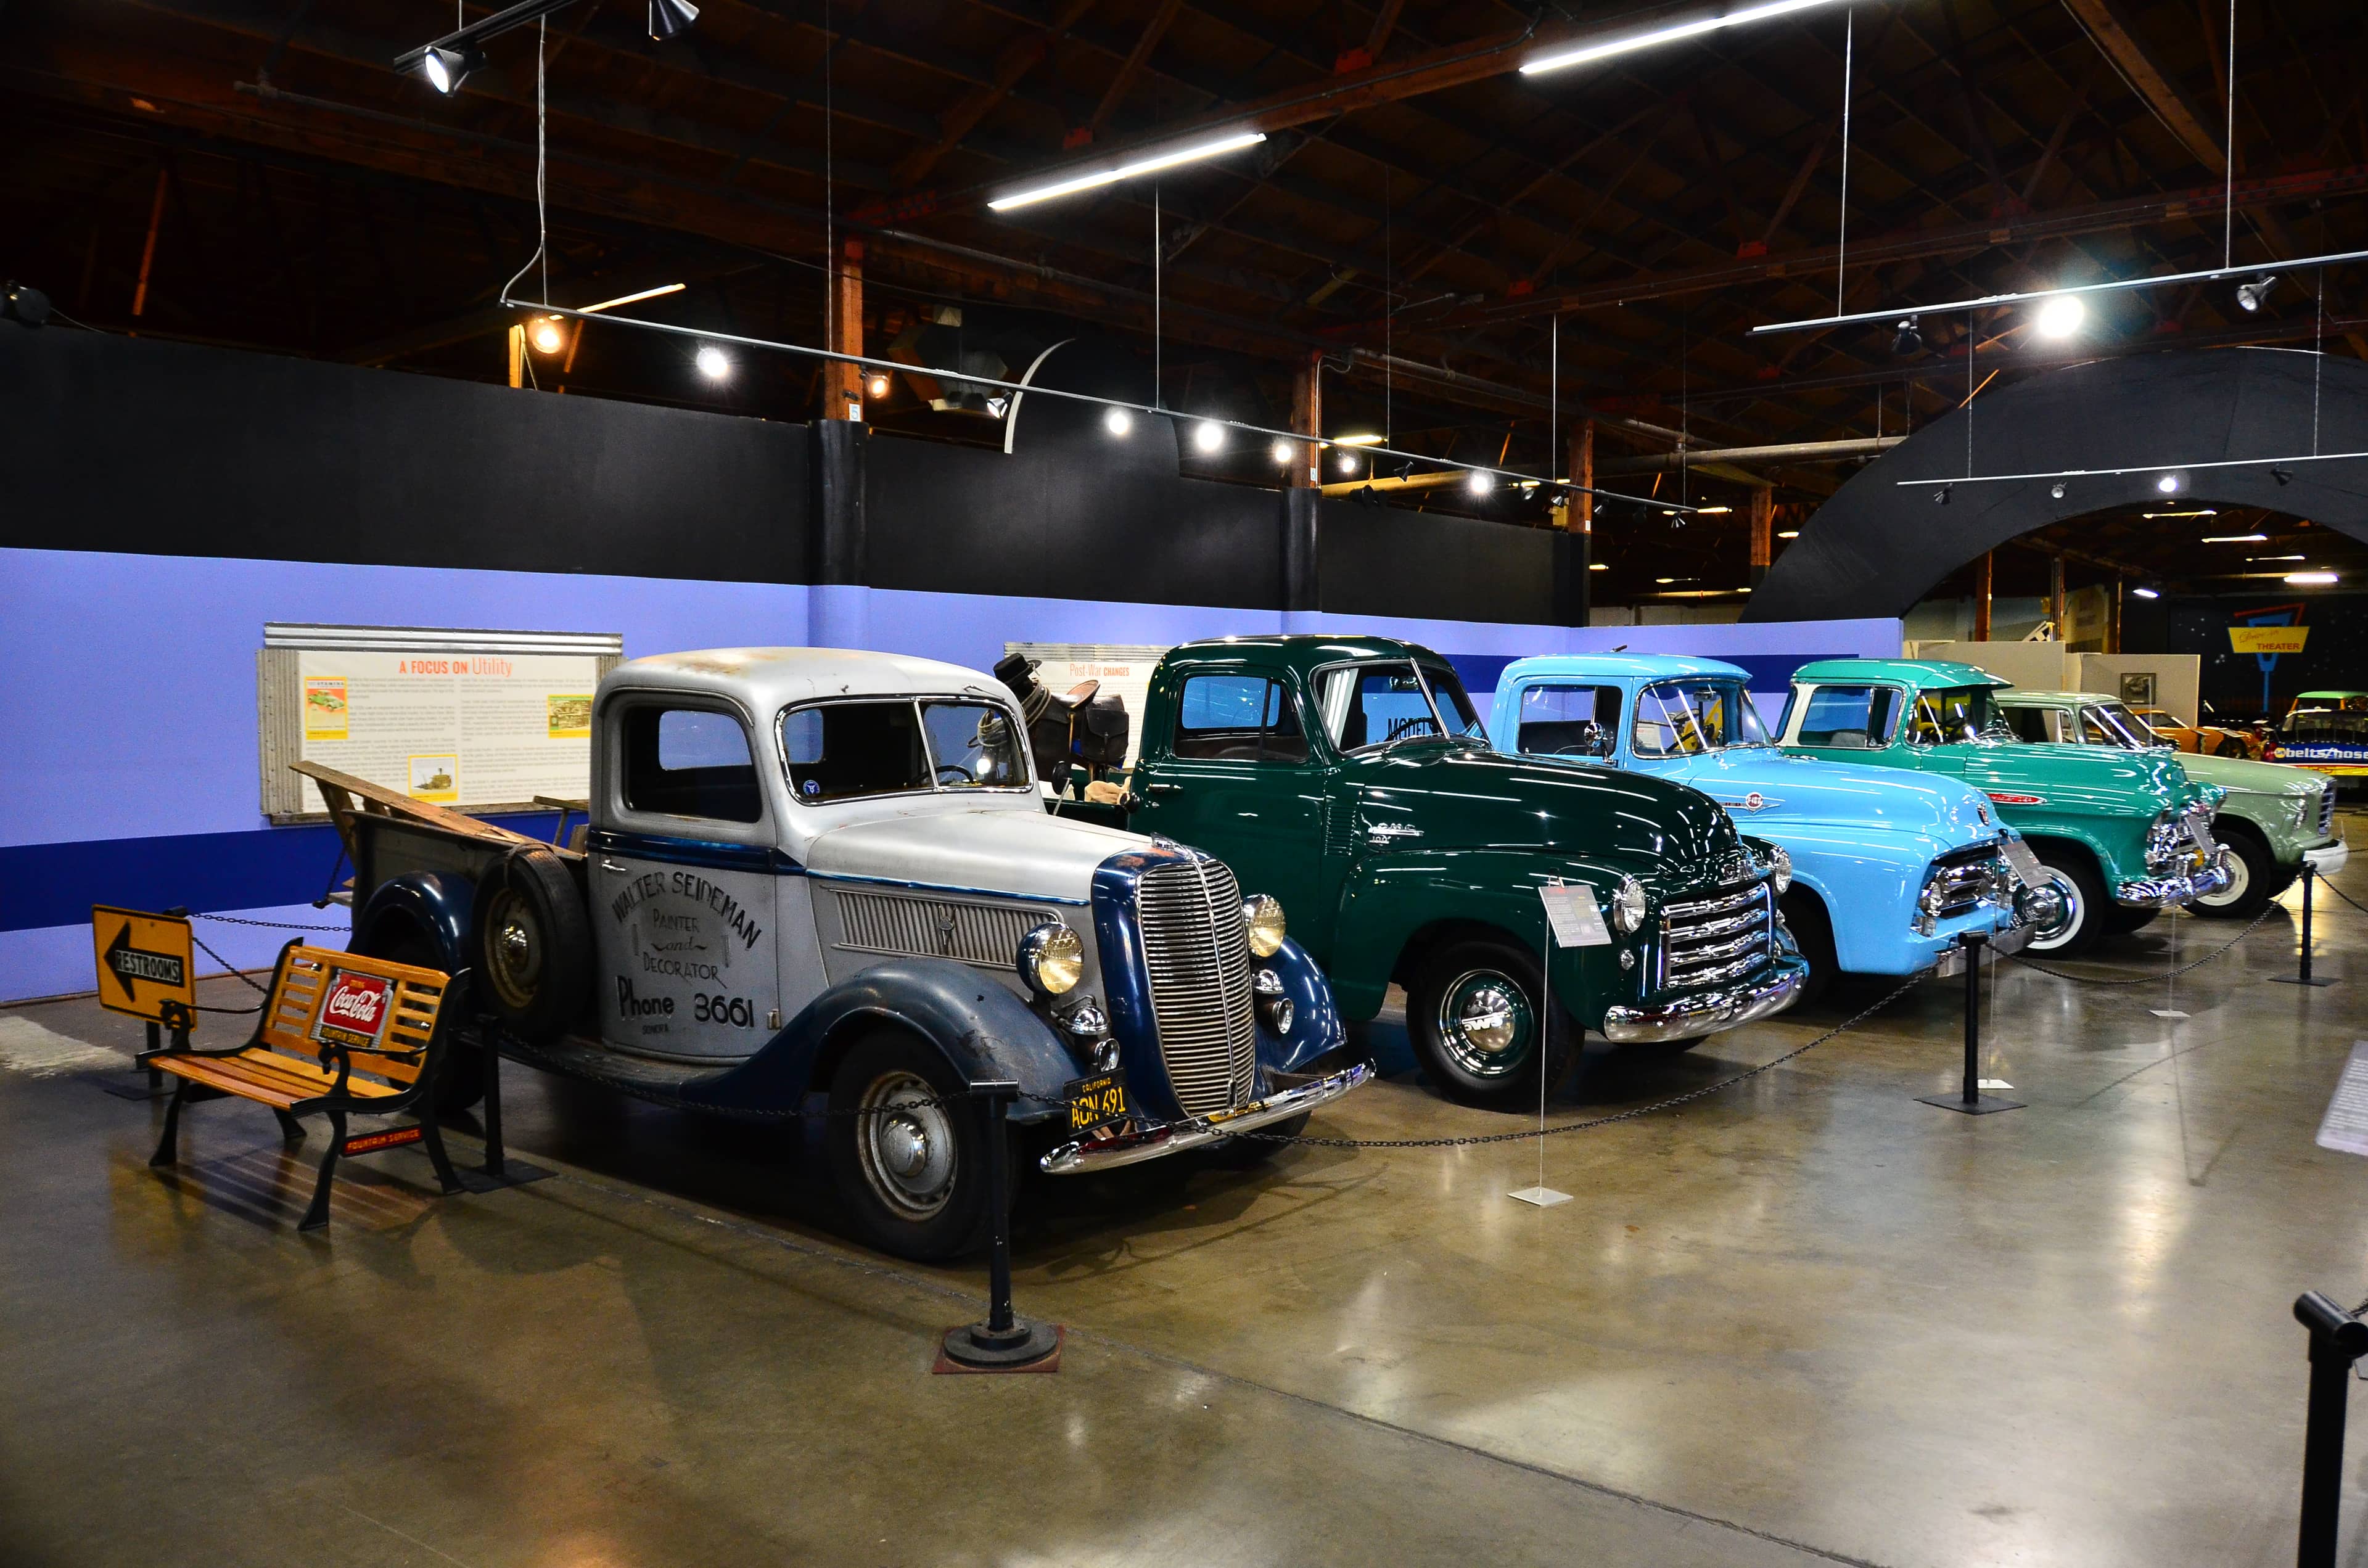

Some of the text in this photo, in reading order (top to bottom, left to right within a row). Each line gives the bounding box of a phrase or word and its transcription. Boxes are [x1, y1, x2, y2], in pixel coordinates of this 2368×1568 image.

[852, 406, 858, 420] 5
[400, 657, 512, 678] A FOCUS ON Utility
[1070, 663, 1130, 676] Post-War CHANGES
[1748, 797, 1762, 805] F-100
[612, 871, 762, 950] WALTER SEIDEMAN
[653, 908, 700, 932] PAINTER
[662, 937, 696, 950] and
[115, 951, 179, 982] RESTROOMS
[643, 952, 727, 988] DECORATOR
[617, 975, 754, 1027] Phone 3661
[347, 1033, 370, 1048] SERVICE
[1082, 1077, 1111, 1093] CALIFORNIA
[1103, 1086, 1125, 1116] 691
[347, 1129, 419, 1150] FOUNTAIN SERVICE
